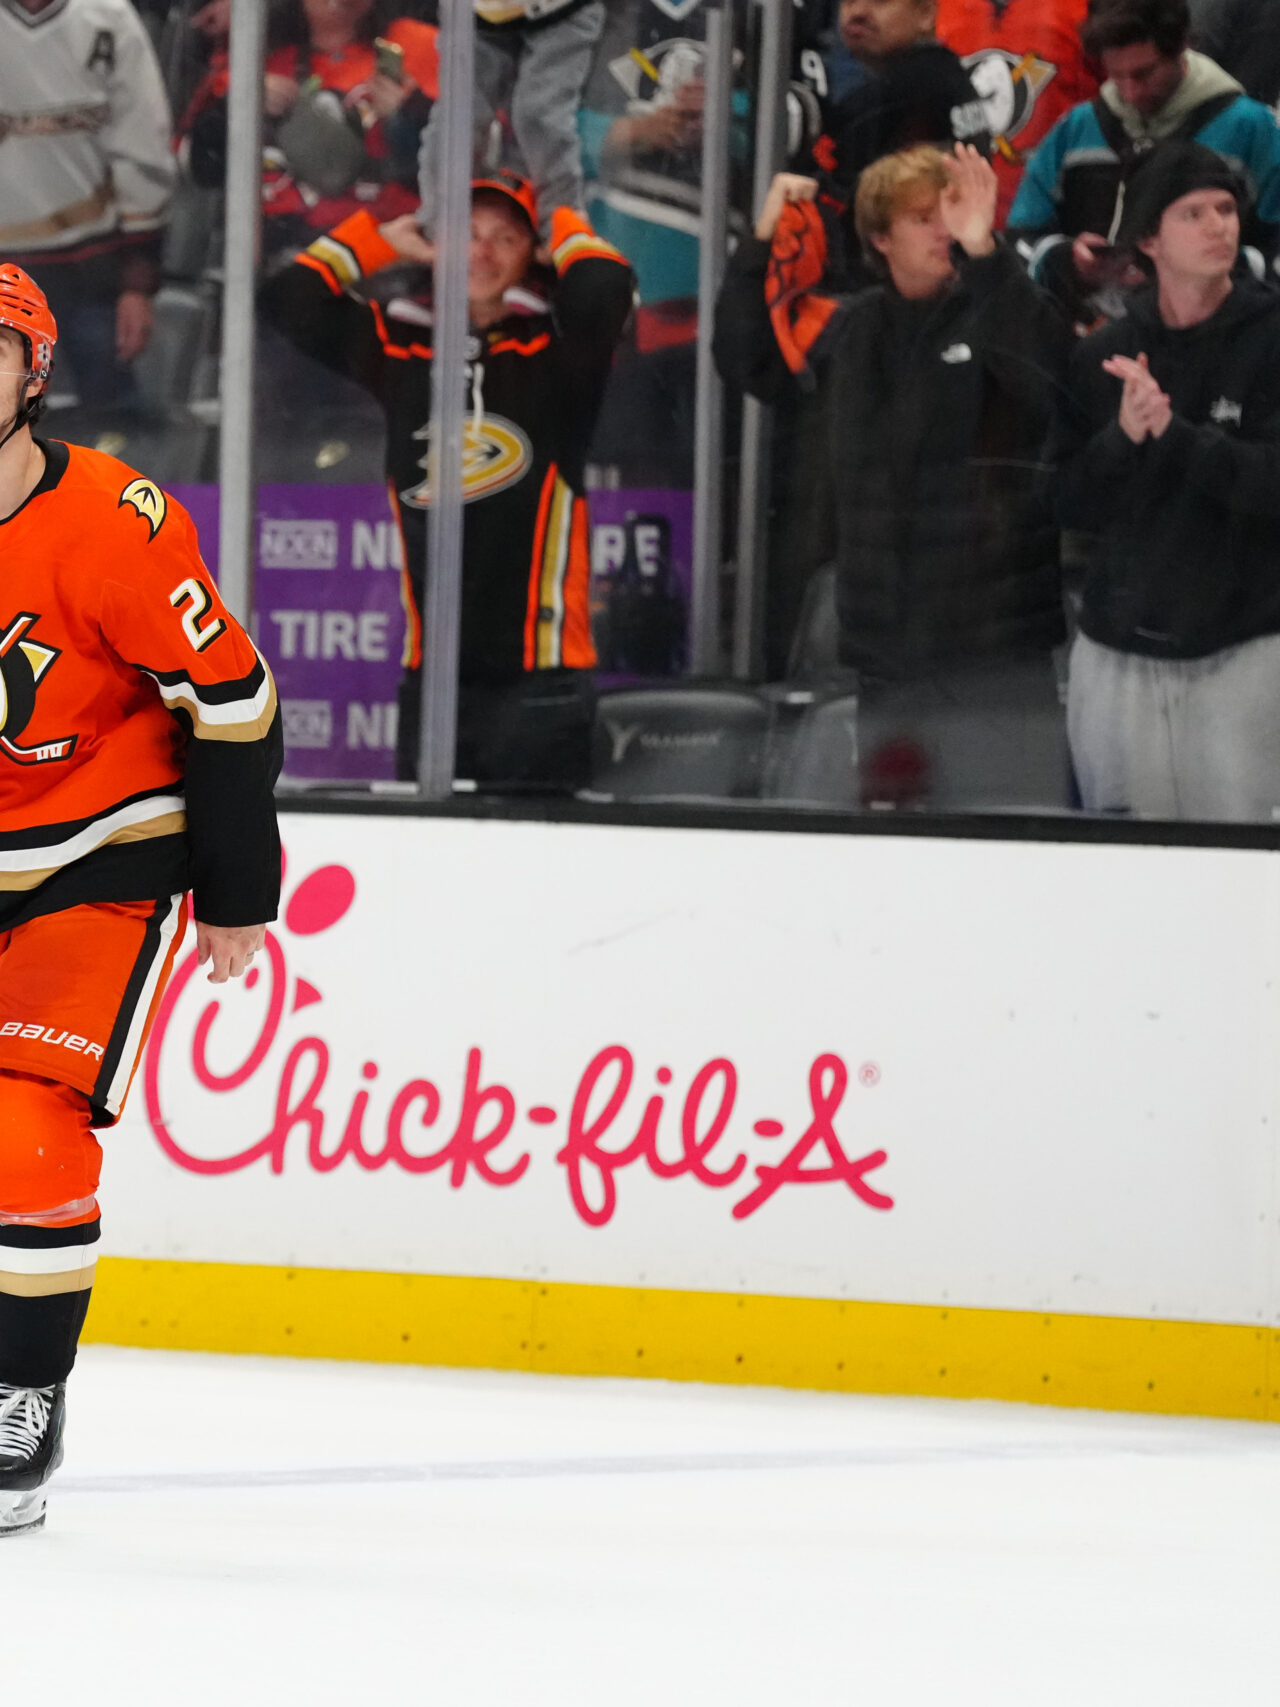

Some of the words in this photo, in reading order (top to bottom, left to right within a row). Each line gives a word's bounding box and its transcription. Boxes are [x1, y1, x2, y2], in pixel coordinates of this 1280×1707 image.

[87, 28, 116, 73] A
[591, 523, 663, 577] RE
[168, 577, 227, 653] 2
[270, 609, 390, 662] TIRE
[145, 925, 894, 1227] Chick-fil-A
